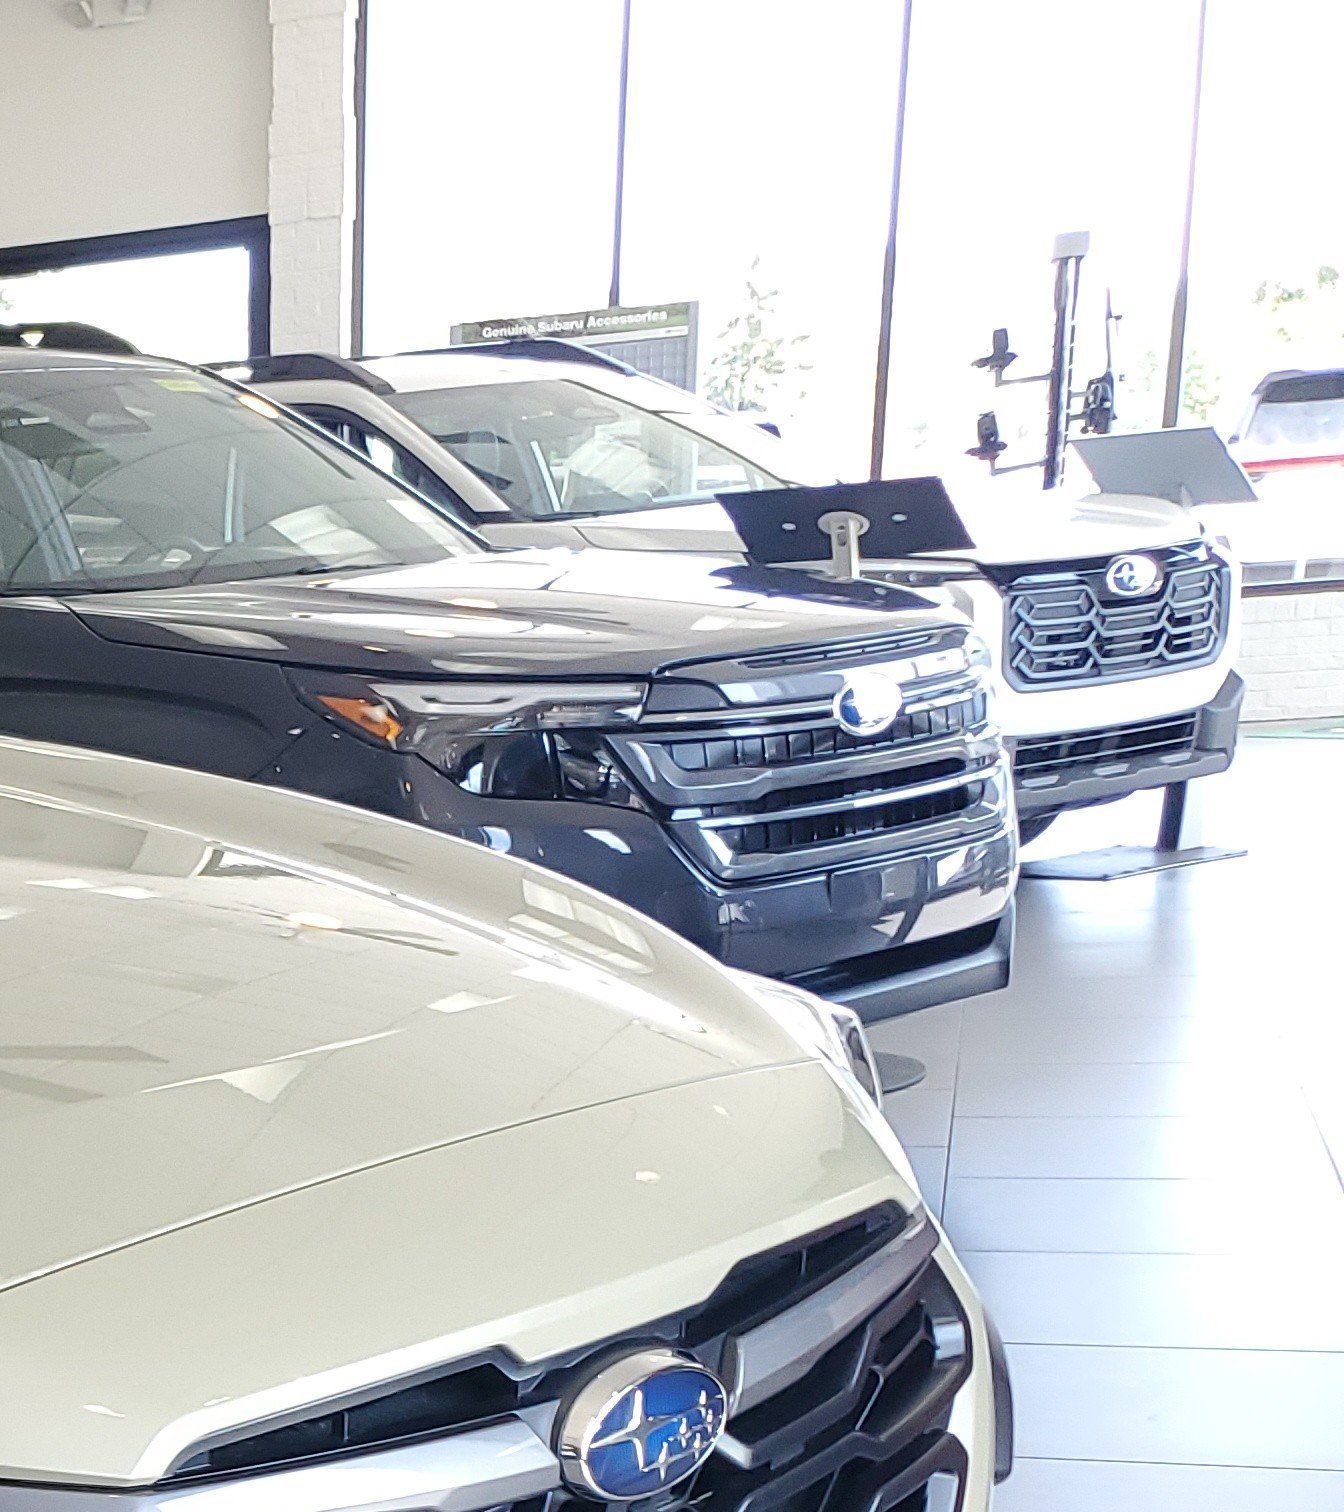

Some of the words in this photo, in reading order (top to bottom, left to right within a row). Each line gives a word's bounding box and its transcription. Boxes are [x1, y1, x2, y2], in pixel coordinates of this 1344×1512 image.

[482, 324, 536, 339] Genuine
[537, 319, 584, 333] Subaru
[586, 309, 668, 329] Accessories
